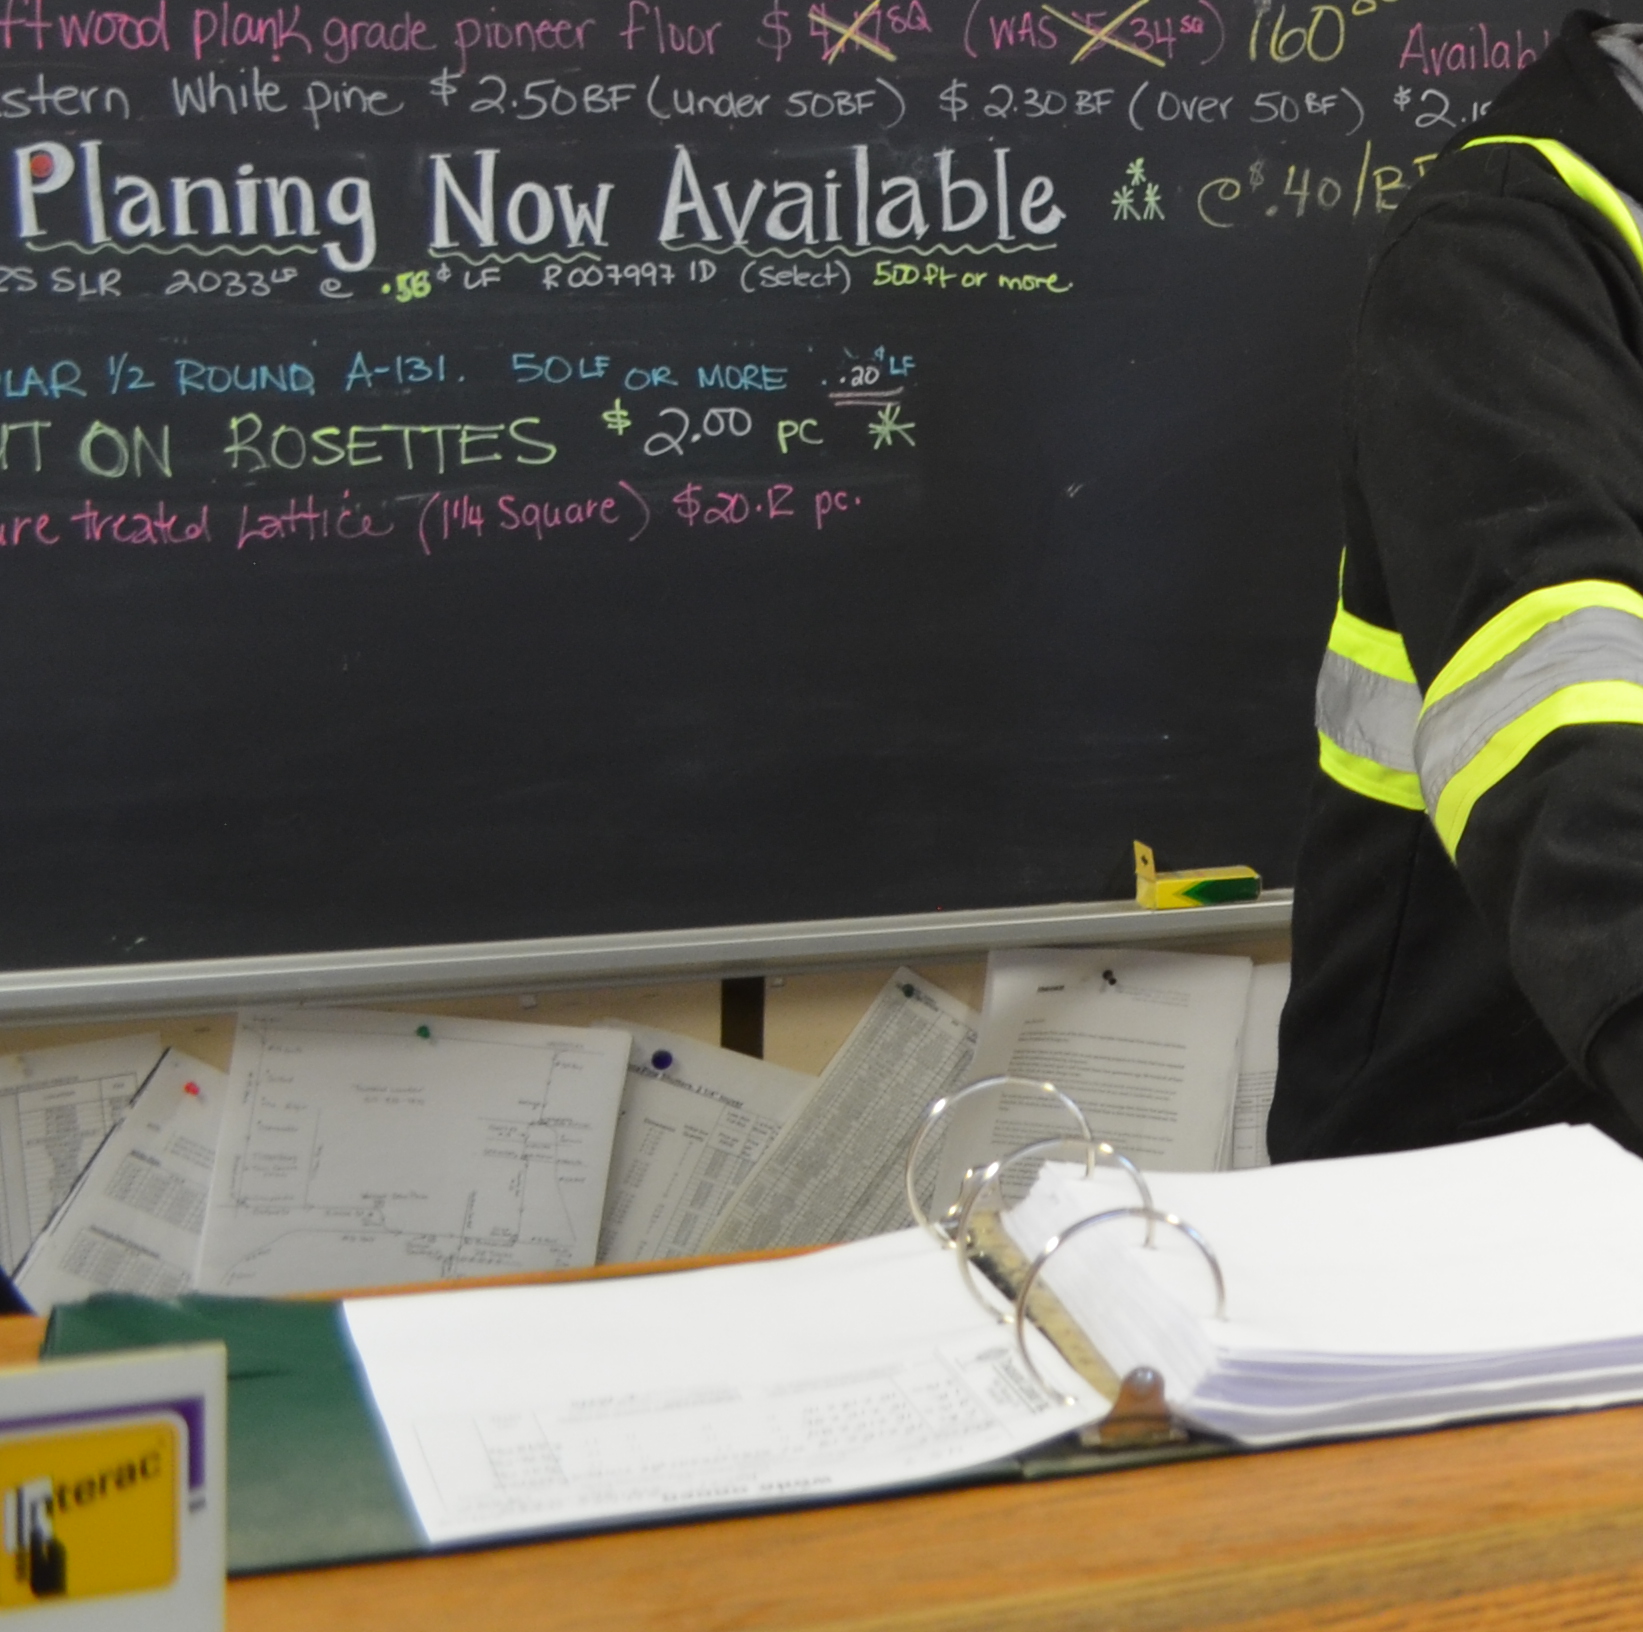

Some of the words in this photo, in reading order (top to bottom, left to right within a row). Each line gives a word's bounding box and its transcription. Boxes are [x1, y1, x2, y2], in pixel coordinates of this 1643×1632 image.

[193, 3, 311, 61] plank
[323, 12, 437, 64] grade
[454, 7, 596, 74] pioneer
[620, 0, 722, 55] floor
[303, 80, 404, 130] pine
[14, 141, 377, 272] Planing
[429, 148, 614, 249] Now
[659, 145, 1066, 247] Available
[961, 272, 987, 289] or
[175, 359, 315, 397] ROUND
[625, 367, 678, 391] OR
[698, 365, 788, 392] MORE
[79, 420, 173, 478] ON
[225, 412, 557, 473] ROSETTES
[70, 499, 212, 543] treated
